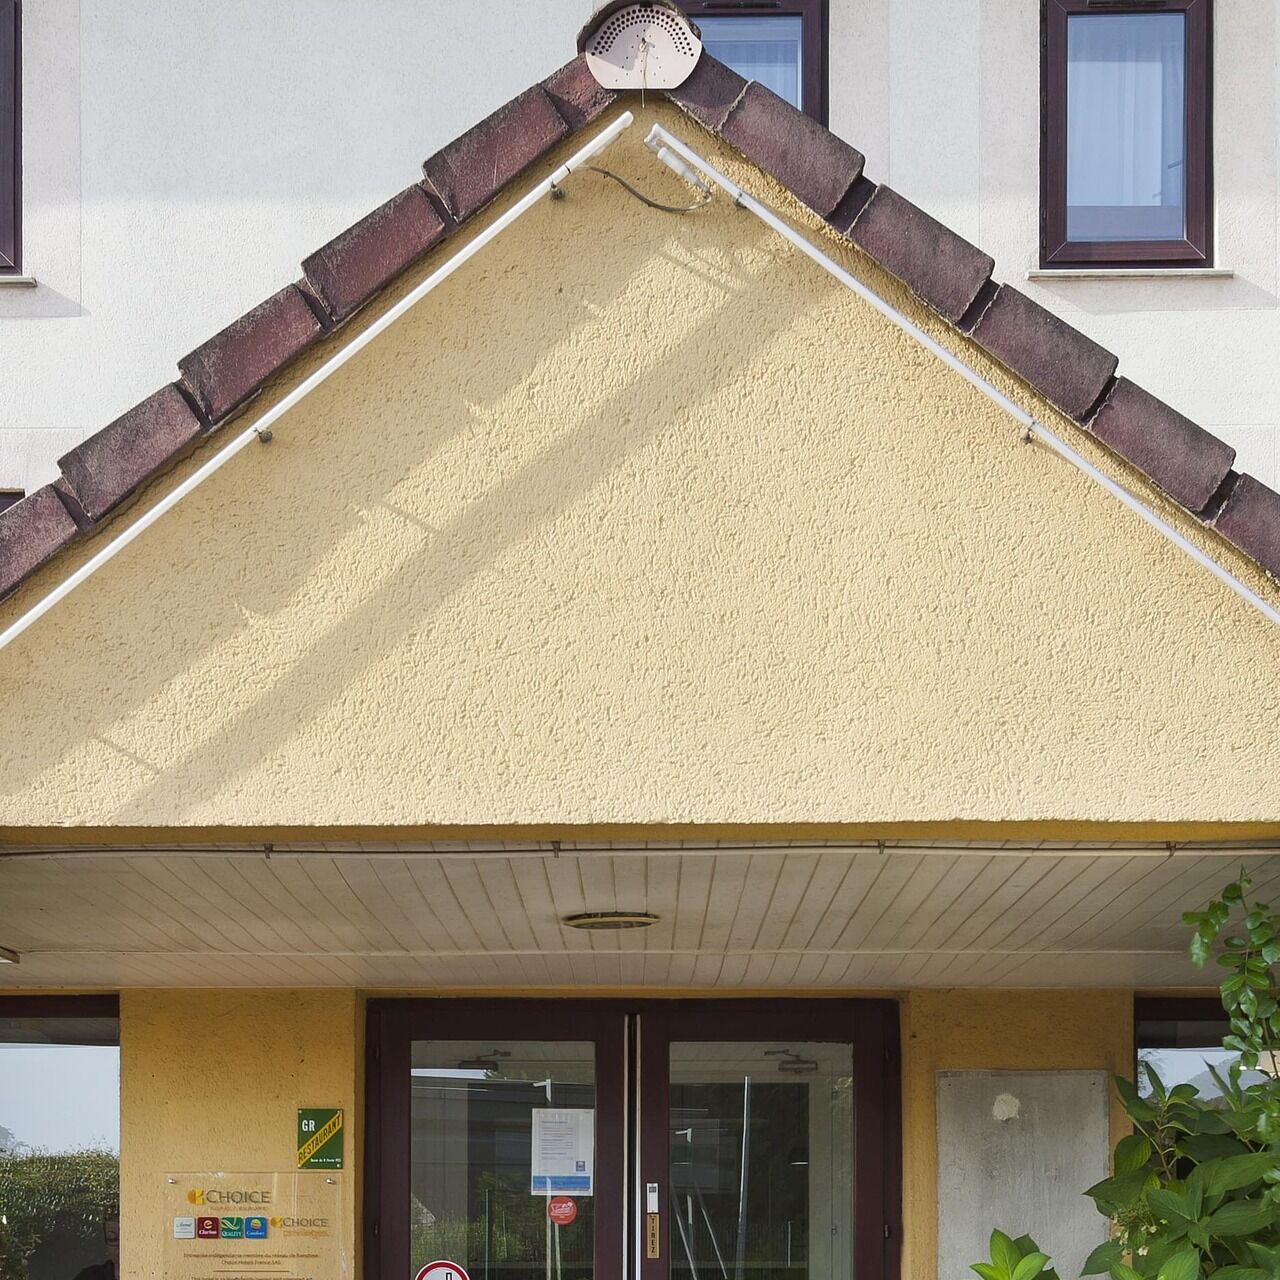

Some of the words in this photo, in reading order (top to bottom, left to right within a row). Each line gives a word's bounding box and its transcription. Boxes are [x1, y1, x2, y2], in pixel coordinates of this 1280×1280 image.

[301, 1119, 316, 1132] GR
[298, 1113, 341, 1165] RESTAURANT
[206, 1189, 271, 1204] CHOICE
[282, 1216, 329, 1228] CHOICE
